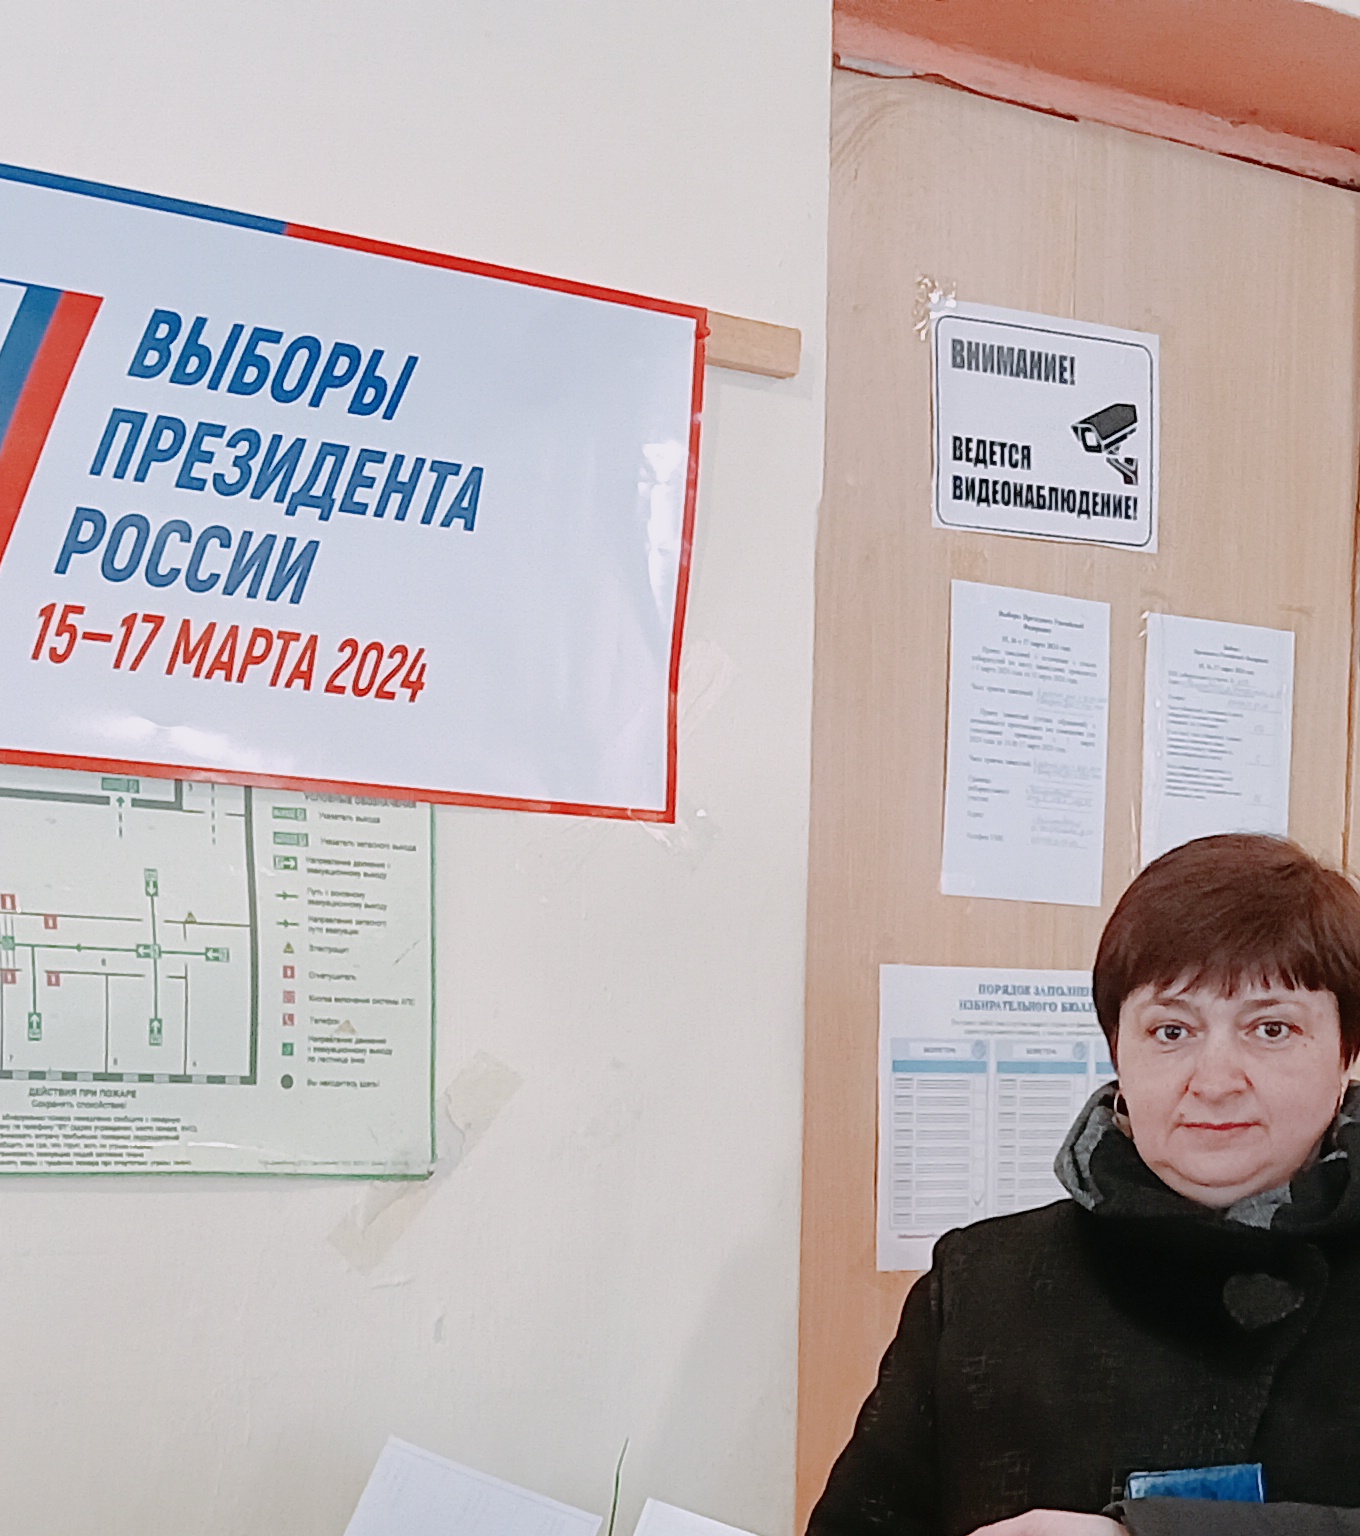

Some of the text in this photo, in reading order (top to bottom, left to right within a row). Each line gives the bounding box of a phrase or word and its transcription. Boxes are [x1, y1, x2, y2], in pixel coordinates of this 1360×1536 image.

[128, 308, 419, 421] ВЫБОРЫ
[951, 338, 1076, 386] ВНИМАНИЕ!
[90, 407, 487, 532] ПРЕЗИДЕНТА
[951, 435, 1031, 470] ВЕДЕТСЯ
[951, 474, 1139, 521] ВИДЕОНАБЛЮДЕНИЕ!
[54, 506, 321, 604] РОССИИ
[165, 622, 323, 693] МАРТА
[324, 636, 429, 703] 2024
